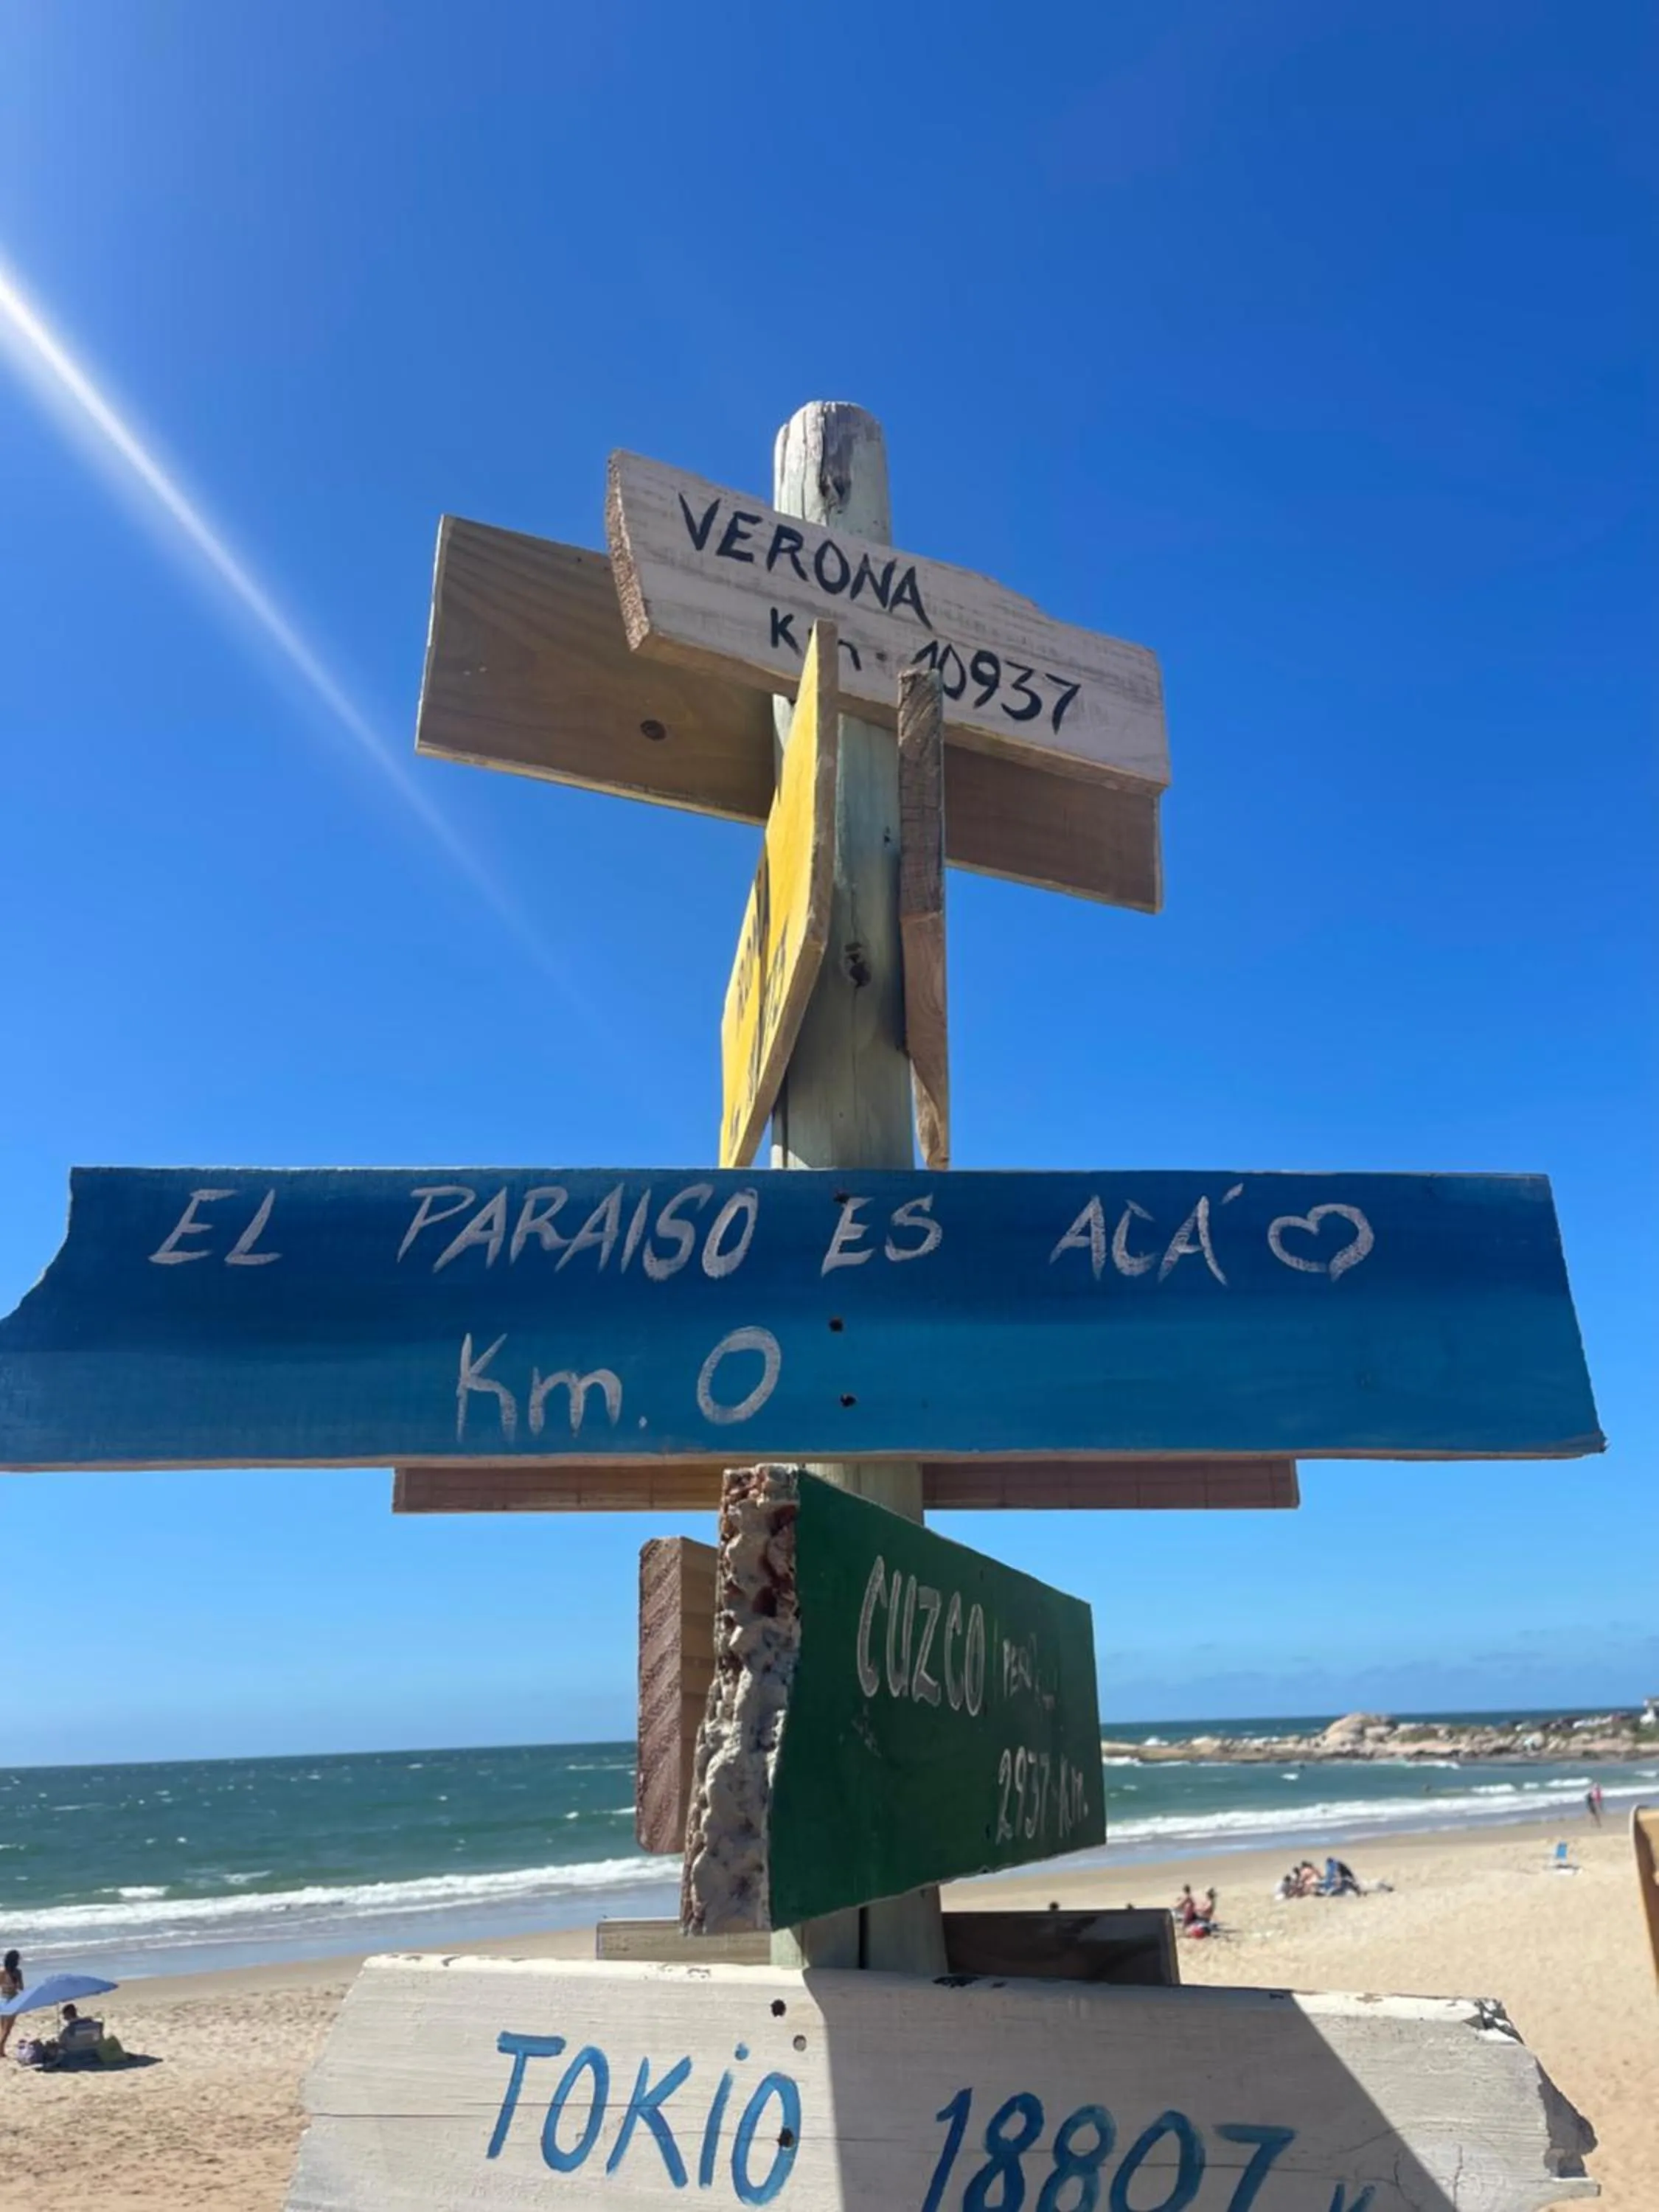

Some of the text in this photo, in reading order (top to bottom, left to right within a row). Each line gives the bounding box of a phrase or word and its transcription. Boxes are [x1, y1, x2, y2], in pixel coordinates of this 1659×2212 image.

[678, 492, 933, 630] VERONA
[911, 640, 1082, 734] 10937
[148, 1183, 1245, 1287] EL PARAISO ES ACÁ
[456, 1332, 648, 1444] Km.
[857, 1554, 987, 1717] CUZCO
[921, 2087, 1299, 2212] 18807
